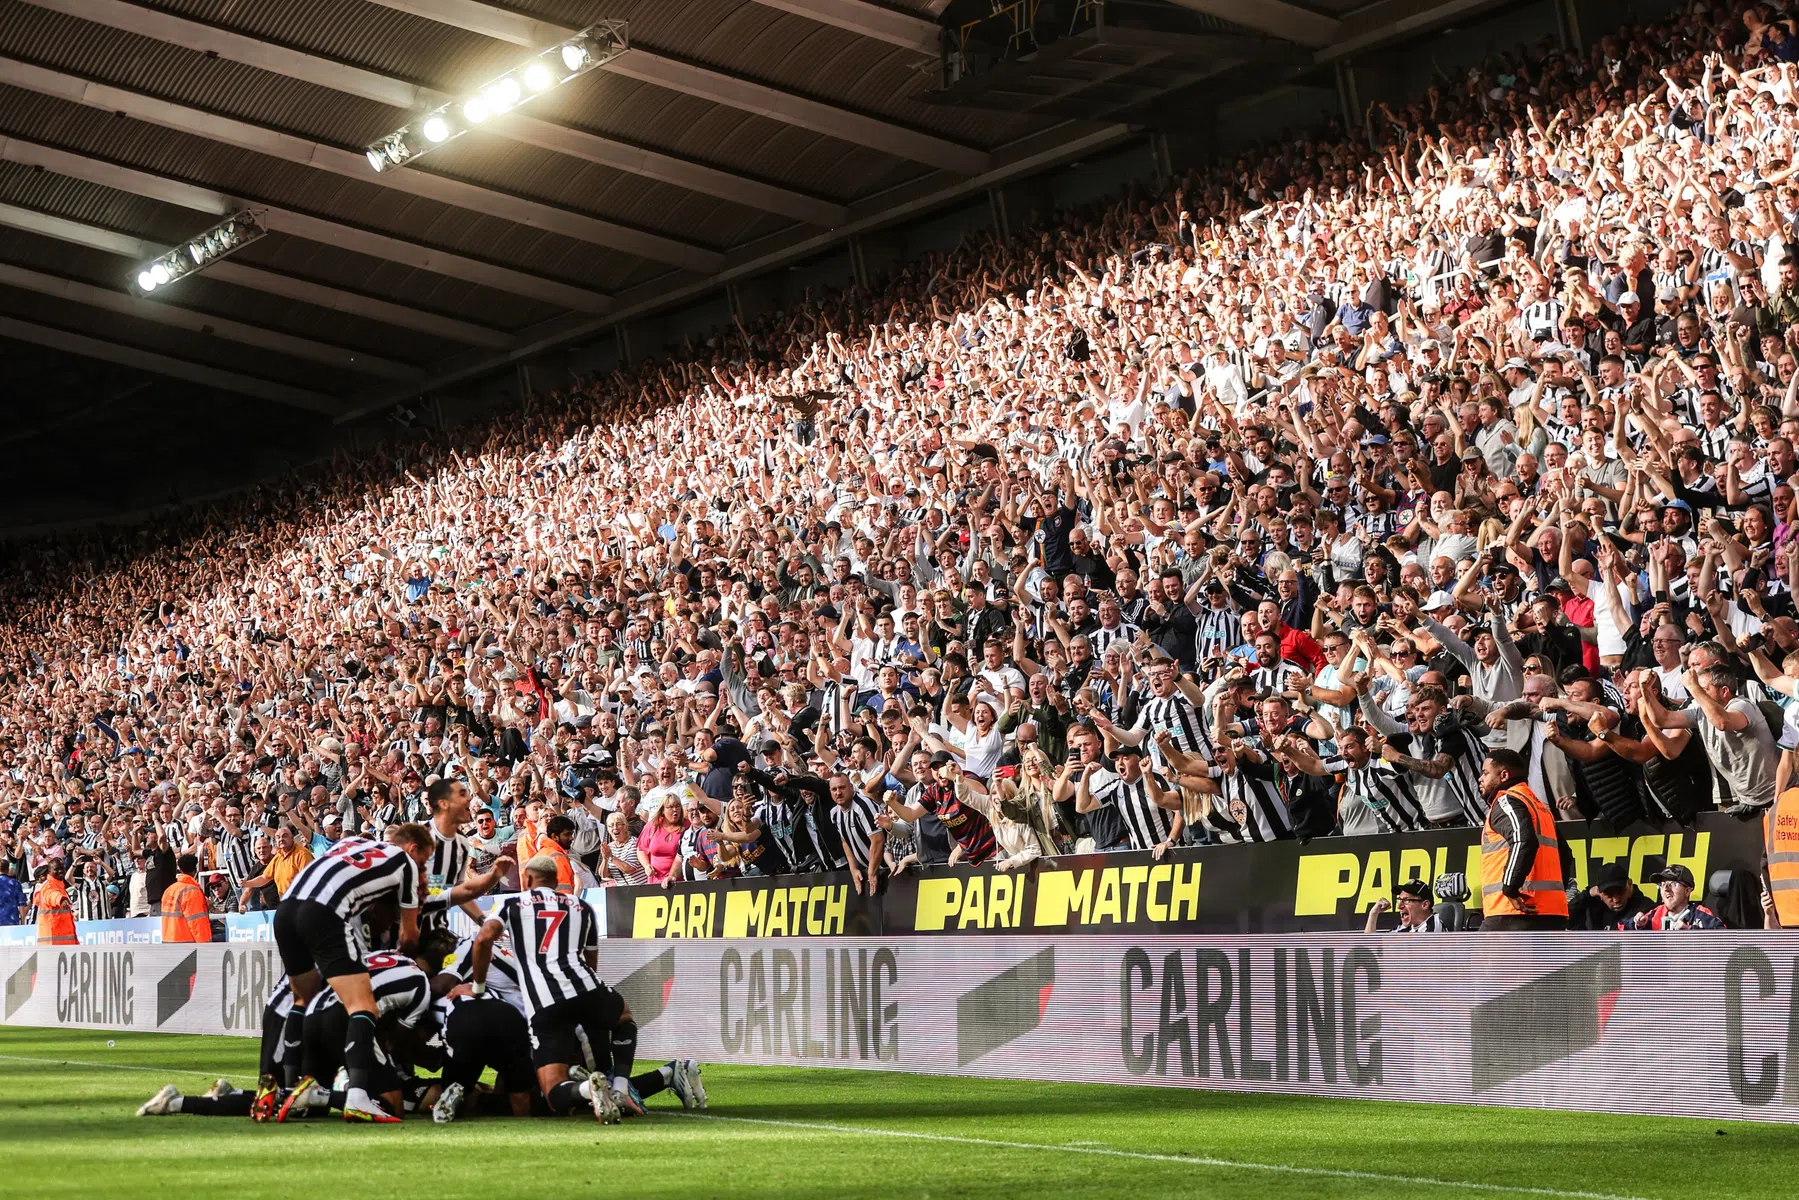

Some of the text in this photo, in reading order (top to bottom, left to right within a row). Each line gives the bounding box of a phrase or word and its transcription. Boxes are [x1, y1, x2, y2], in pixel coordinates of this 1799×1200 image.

[1776, 815, 1798, 829] Safety
[632, 885, 848, 938] PARI MATCH
[914, 863, 1202, 931] PARI MATCH
[536, 910, 568, 954] 7
[57, 951, 134, 1026] CARLING
[720, 947, 899, 1062] CARLING
[1120, 947, 1383, 1087] CARLING
